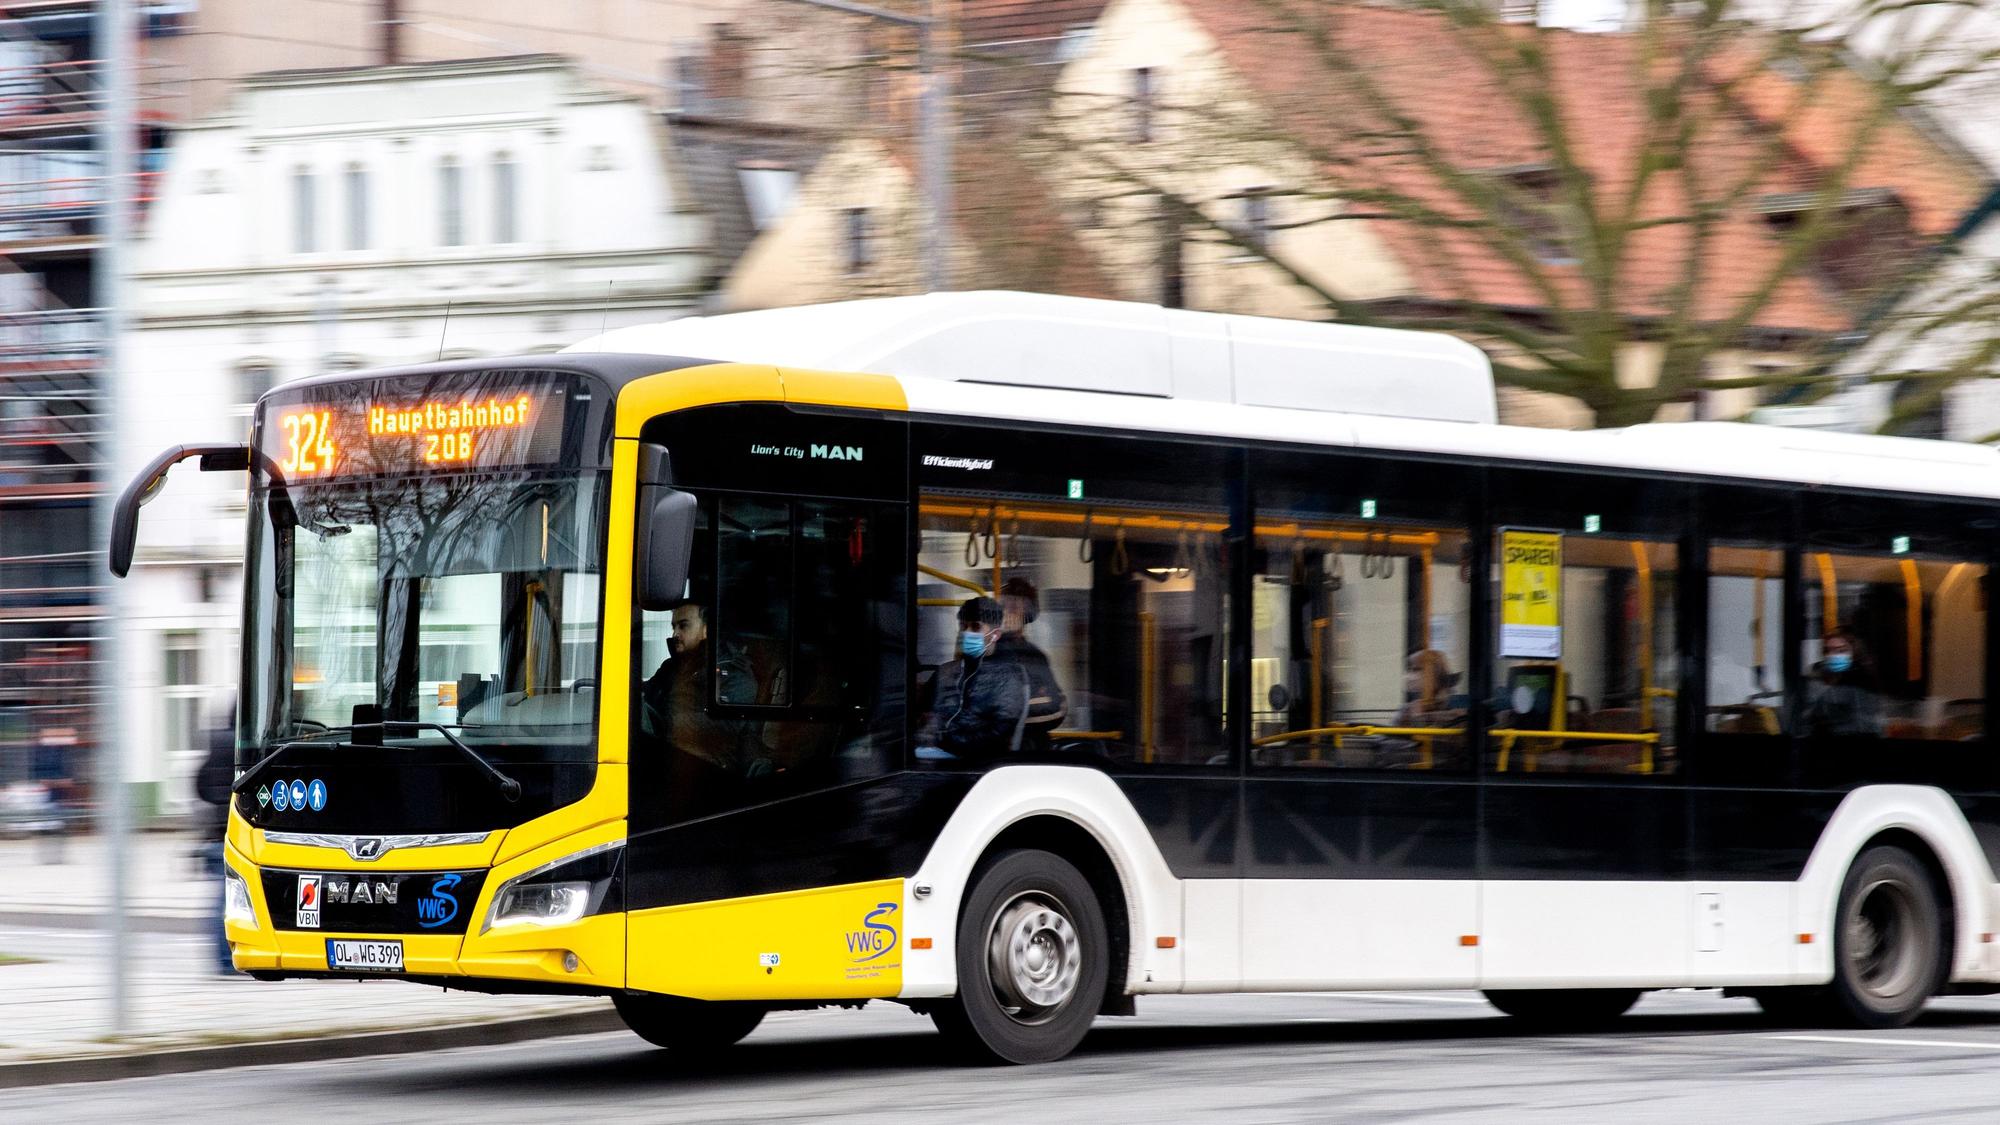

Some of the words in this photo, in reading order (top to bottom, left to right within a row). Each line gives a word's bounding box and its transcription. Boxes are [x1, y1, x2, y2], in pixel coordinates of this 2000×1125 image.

[369, 397, 530, 434] Hauptbahnhof
[281, 412, 335, 473] 324
[425, 433, 472, 462] ZOB
[751, 444, 780, 456] Lion's
[784, 446, 804, 459] City
[810, 443, 863, 461] MAN
[922, 455, 994, 470] EfficientHybrid
[327, 881, 399, 904] MAN
[297, 911, 319, 926] VBN
[417, 897, 447, 920] VWG
[846, 930, 883, 953] VWG
[335, 943, 352, 962] OL
[359, 944, 376, 964] WG
[378, 945, 401, 964] 399
